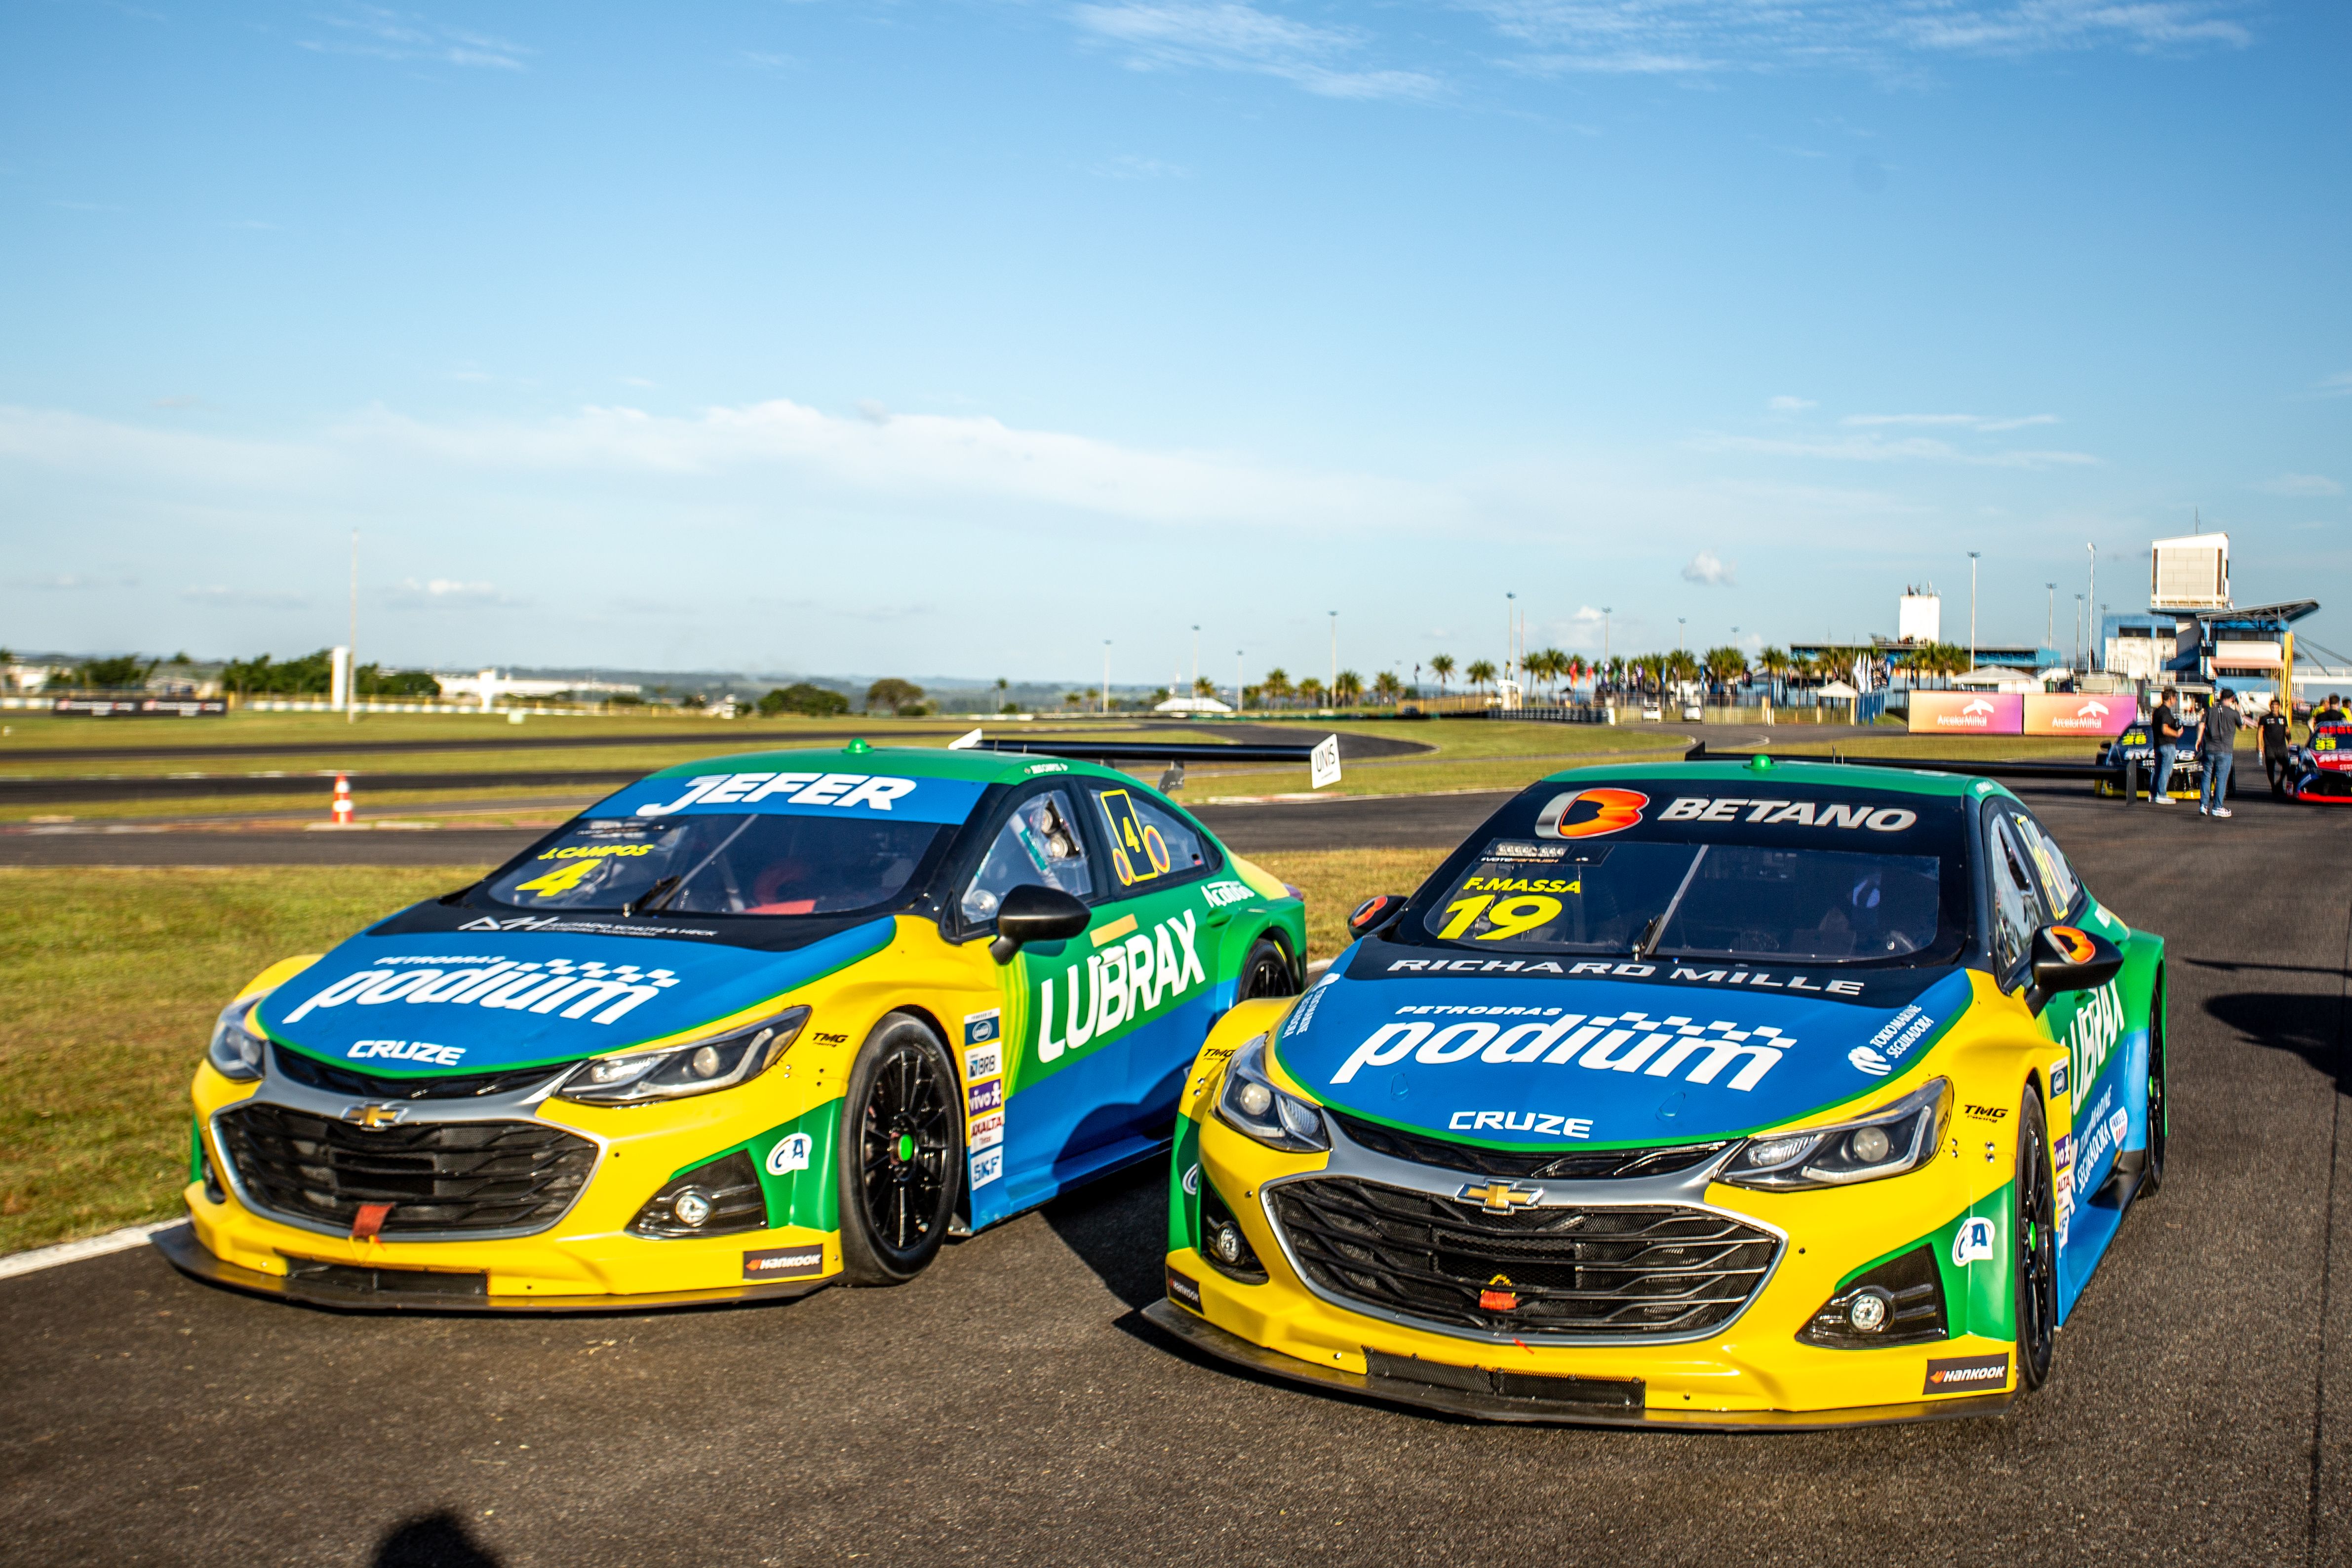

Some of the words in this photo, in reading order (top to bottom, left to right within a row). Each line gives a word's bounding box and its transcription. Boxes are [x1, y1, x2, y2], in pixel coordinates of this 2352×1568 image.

[1937, 714, 1987, 727] ArcelorMittal
[2052, 716, 2102, 729] ArcelorMittal
[636, 772, 917, 817] JEFER
[1657, 797, 1917, 831] BETANO
[1122, 816, 1141, 853] 4
[515, 859, 603, 897] 4
[1462, 877, 1580, 894] F.MASSA
[1437, 894, 1563, 941] 19
[373, 956, 506, 965] PETROBRAS
[1038, 908, 1206, 1063] LUBRAX
[1387, 959, 1656, 977] RICHARD
[1669, 967, 1865, 996] MILLE
[282, 960, 661, 1025] podium
[1395, 1006, 1564, 1016] PETROBRAS
[813, 1033, 849, 1043] TMG
[1869, 1024, 1898, 1049] TOKIO
[1889, 1004, 1922, 1030] MARINE
[1886, 1015, 1934, 1059] SEGURADORA
[347, 1040, 467, 1066] CRUZE
[1329, 1013, 1784, 1092] podium
[2060, 978, 2125, 1116] UBRAX
[978, 1055, 995, 1075] BRB
[969, 1089, 992, 1112] vivo
[1964, 1104, 2008, 1118] TMG
[971, 1116, 1002, 1137] AXALTA
[1448, 1111, 1594, 1139] CRUZE
[974, 1155, 1000, 1182] SKF
